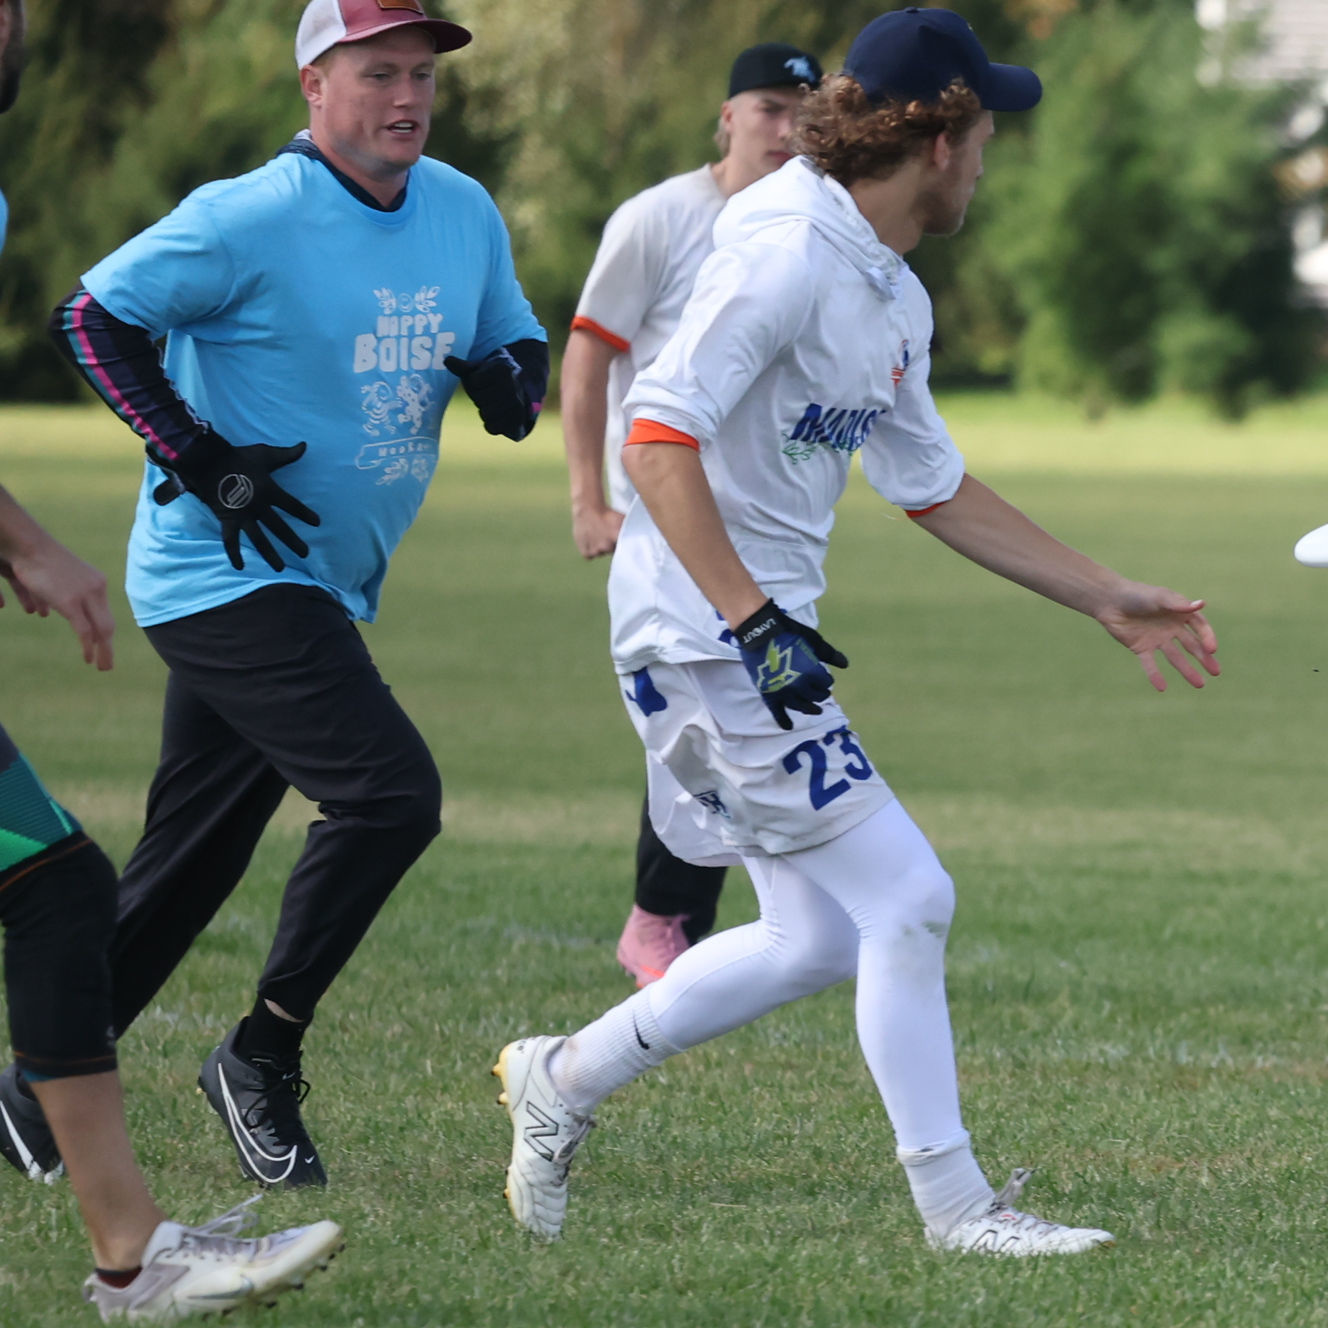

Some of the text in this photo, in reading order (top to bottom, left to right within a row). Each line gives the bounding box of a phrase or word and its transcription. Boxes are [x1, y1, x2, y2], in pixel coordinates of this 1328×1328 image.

[353, 331, 456, 373] BOISE
[743, 617, 777, 644] LAYOUT
[782, 725, 873, 811] 23
